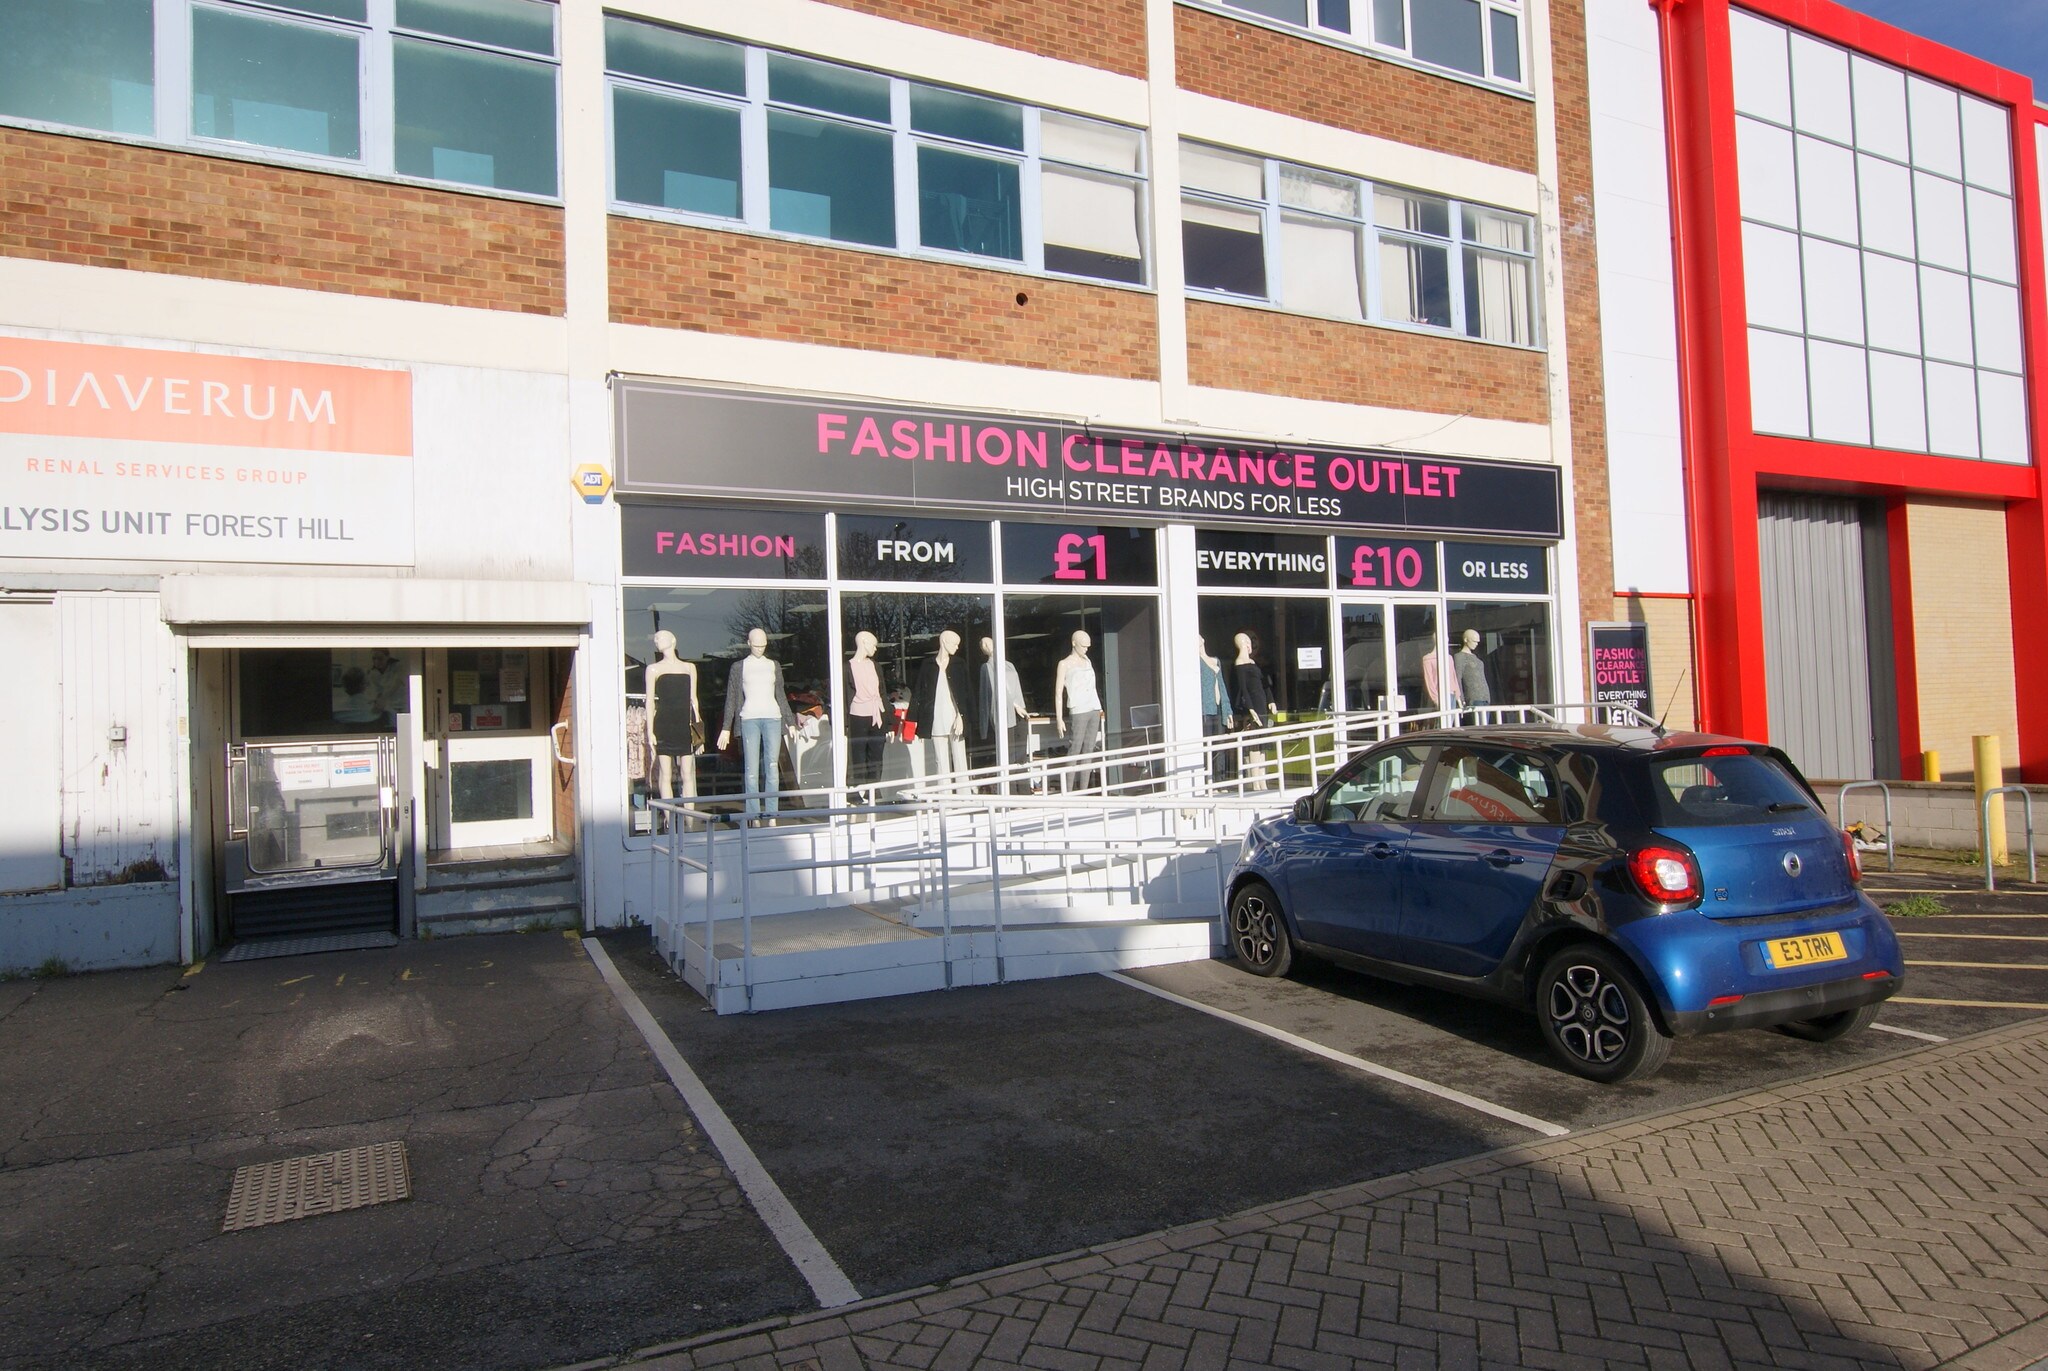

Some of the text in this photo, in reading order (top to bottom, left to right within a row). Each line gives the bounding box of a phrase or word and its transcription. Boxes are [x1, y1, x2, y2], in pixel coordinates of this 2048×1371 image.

[0, 364, 337, 426] DIAVERUM
[816, 412, 1461, 498] FASHION CLEARANCE OUTLET
[27, 457, 308, 485] RENAL SERVICES GROUP
[584, 473, 602, 485] ADT
[1006, 476, 1342, 516] HIGH STREET BRANDS FOR LESS
[0, 506, 354, 541] LYSIS UNIT FOREST HILL
[656, 531, 1107, 581] FASHION FROM £1
[1196, 545, 1529, 588] EVERYTHING £10 OR LESS
[1595, 648, 1645, 660] FASHION
[1596, 661, 1645, 671] CLEARANCE
[1597, 670, 1645, 684] OUTLET
[1598, 690, 1647, 700] EVERYTHING
[1780, 936, 1834, 961] E3 TRN
